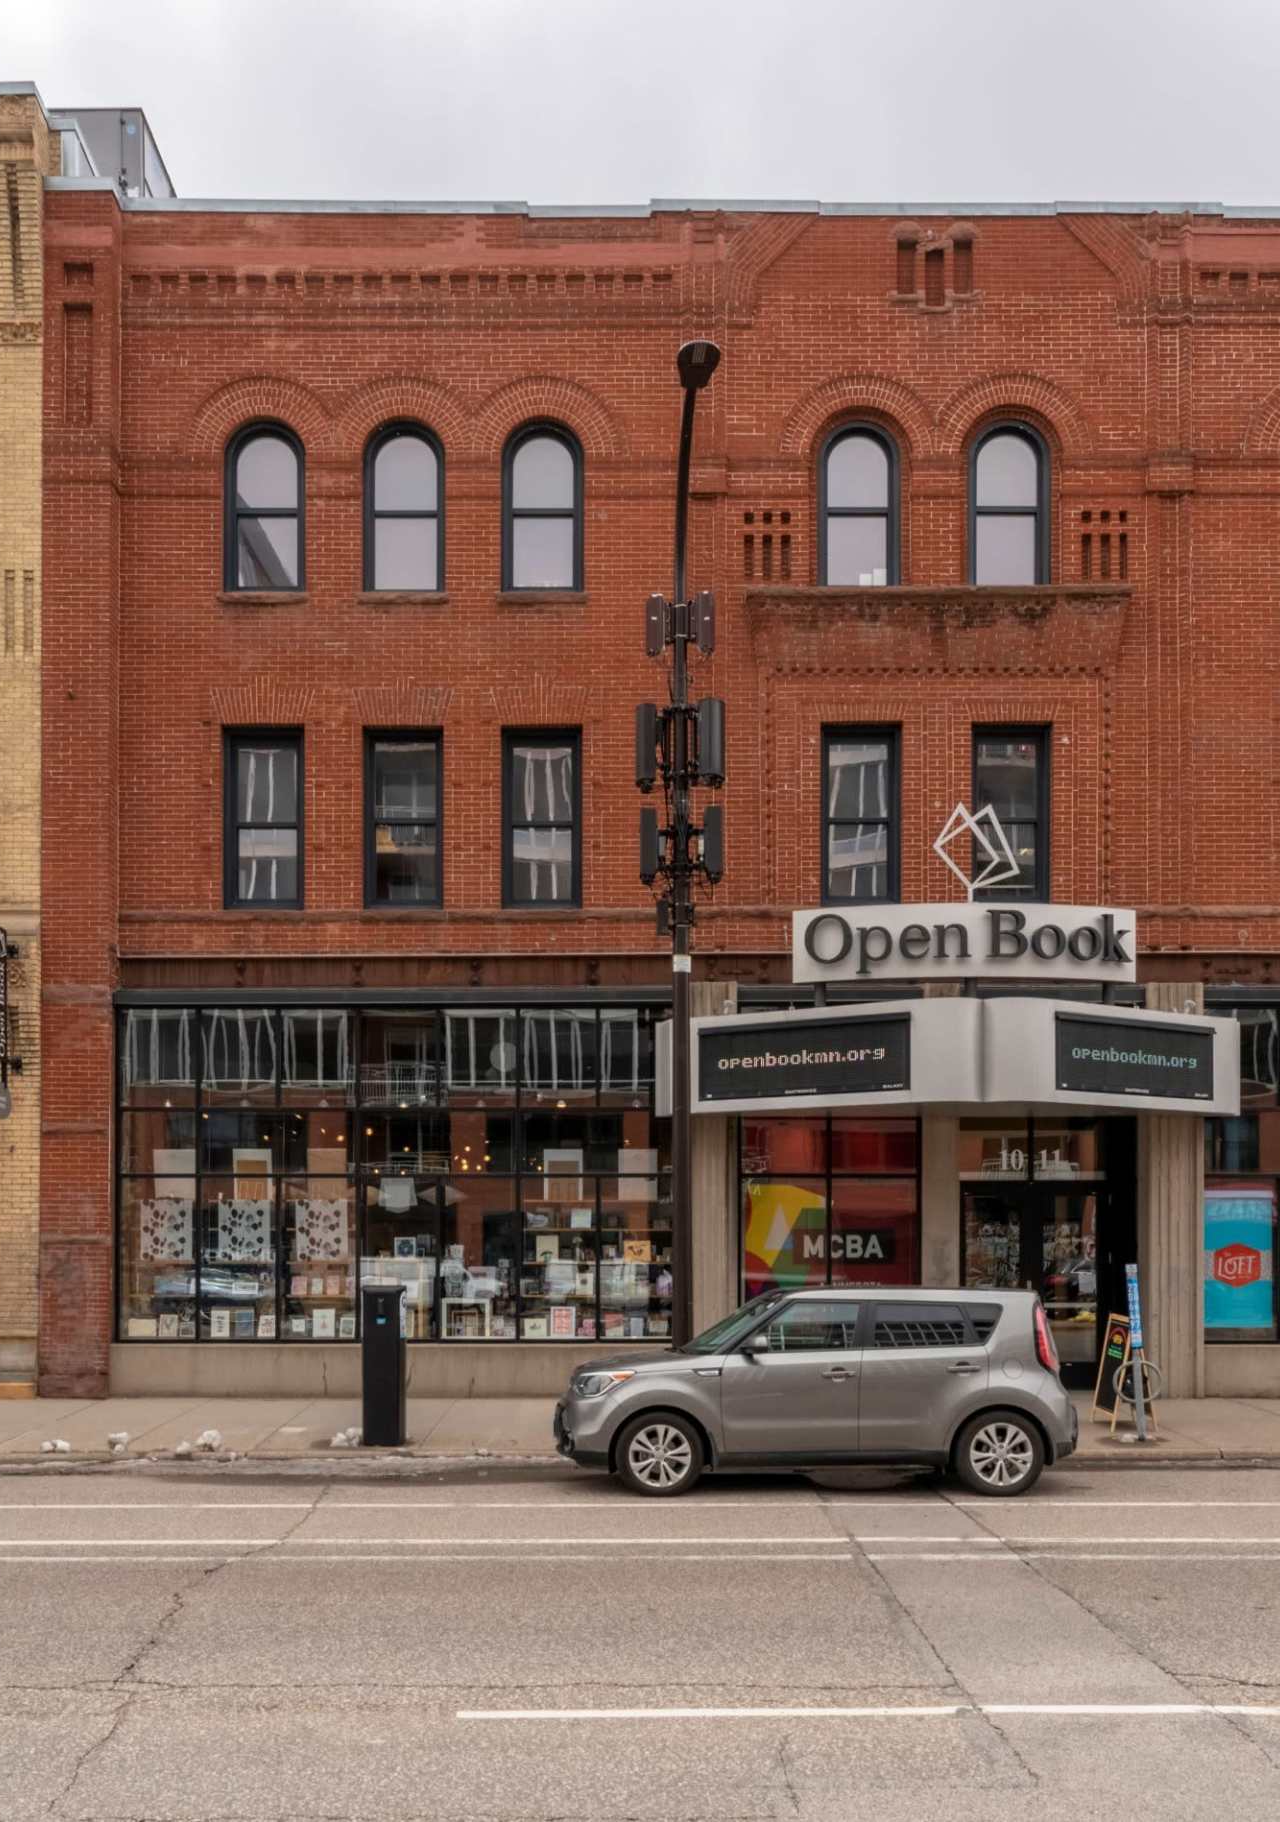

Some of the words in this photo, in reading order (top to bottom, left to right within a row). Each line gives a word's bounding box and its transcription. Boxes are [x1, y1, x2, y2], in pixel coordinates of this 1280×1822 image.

[804, 913, 972, 975] Open
[985, 909, 1133, 963] Book
[718, 1047, 885, 1070] openbookmn.org
[1072, 1047, 1198, 1069] openbookmn.org
[1000, 1149, 1024, 1170] 10
[803, 1234, 884, 1259] MCBA
[1218, 1255, 1256, 1280] LOFT
